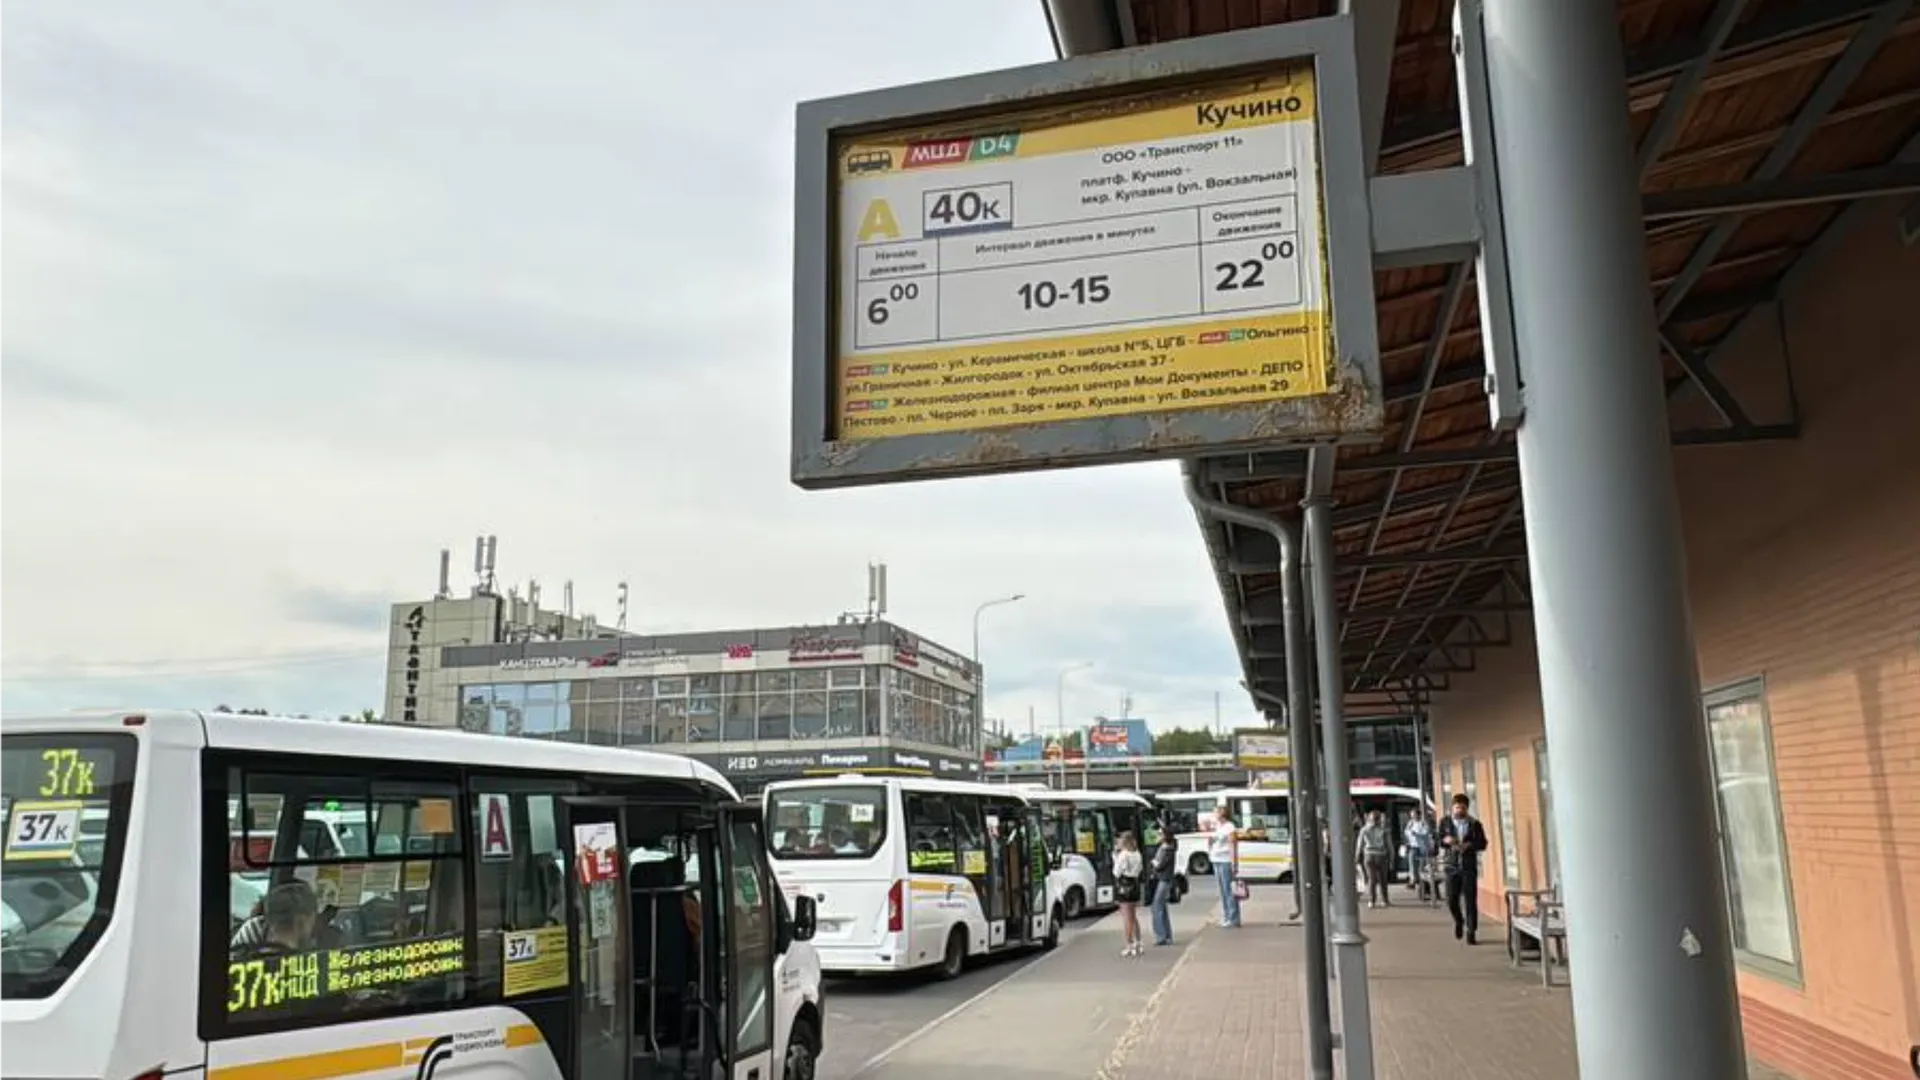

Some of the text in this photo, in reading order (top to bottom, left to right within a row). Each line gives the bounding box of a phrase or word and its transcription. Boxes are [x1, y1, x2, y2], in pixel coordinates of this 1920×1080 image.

[1197, 96, 1301, 128] Кучино
[910, 135, 1012, 162] МЦД D4
[1102, 150, 1136, 164] ООО
[1081, 171, 1128, 188] платф.
[1132, 166, 1183, 183] Кучино
[1081, 191, 1111, 205] мкр.
[1115, 185, 1174, 201] Купавна
[857, 198, 899, 241] А
[1213, 206, 1282, 222] Окончание
[975, 240, 1032, 254] Интервал
[1033, 233, 1094, 249] движения
[1107, 225, 1156, 240] минутах
[1218, 221, 1282, 237] движения
[875, 249, 918, 261] Начало
[869, 262, 926, 276] движения
[1017, 275, 1111, 310] 10-15
[892, 360, 938, 374] Кучино
[949, 359, 965, 372] ул.
[971, 349, 1066, 367] Керамическая
[1077, 344, 1121, 357] школа
[1156, 336, 1186, 350] ЦГБ
[1247, 325, 1309, 341] Ольгино
[893, 388, 1015, 407] Железнодорожная
[1027, 383, 1080, 397] филиал
[1083, 378, 1130, 392] центра
[1134, 375, 1163, 387] Мои
[1167, 368, 1248, 385] Документы
[1259, 360, 1304, 377] ДЕПО
[941, 369, 1024, 387] Жилгородок
[1035, 368, 1054, 381] ул.
[1057, 358, 1146, 376] Октябрьская
[1150, 355, 1167, 367] 37
[843, 415, 896, 428] Пестово
[907, 412, 926, 424] пл.
[929, 408, 978, 422] Черное
[988, 405, 1008, 417] пл.
[1011, 402, 1045, 415] Заря
[1055, 400, 1084, 412] мкр.
[1088, 394, 1145, 408] Купавна
[1156, 391, 1177, 403] ул.
[1181, 382, 1266, 399] Вокзальная
[1270, 379, 1290, 392] 29
[487, 797, 509, 853] А
[279, 953, 319, 977] МЦД
[279, 974, 319, 1000] МЦД
